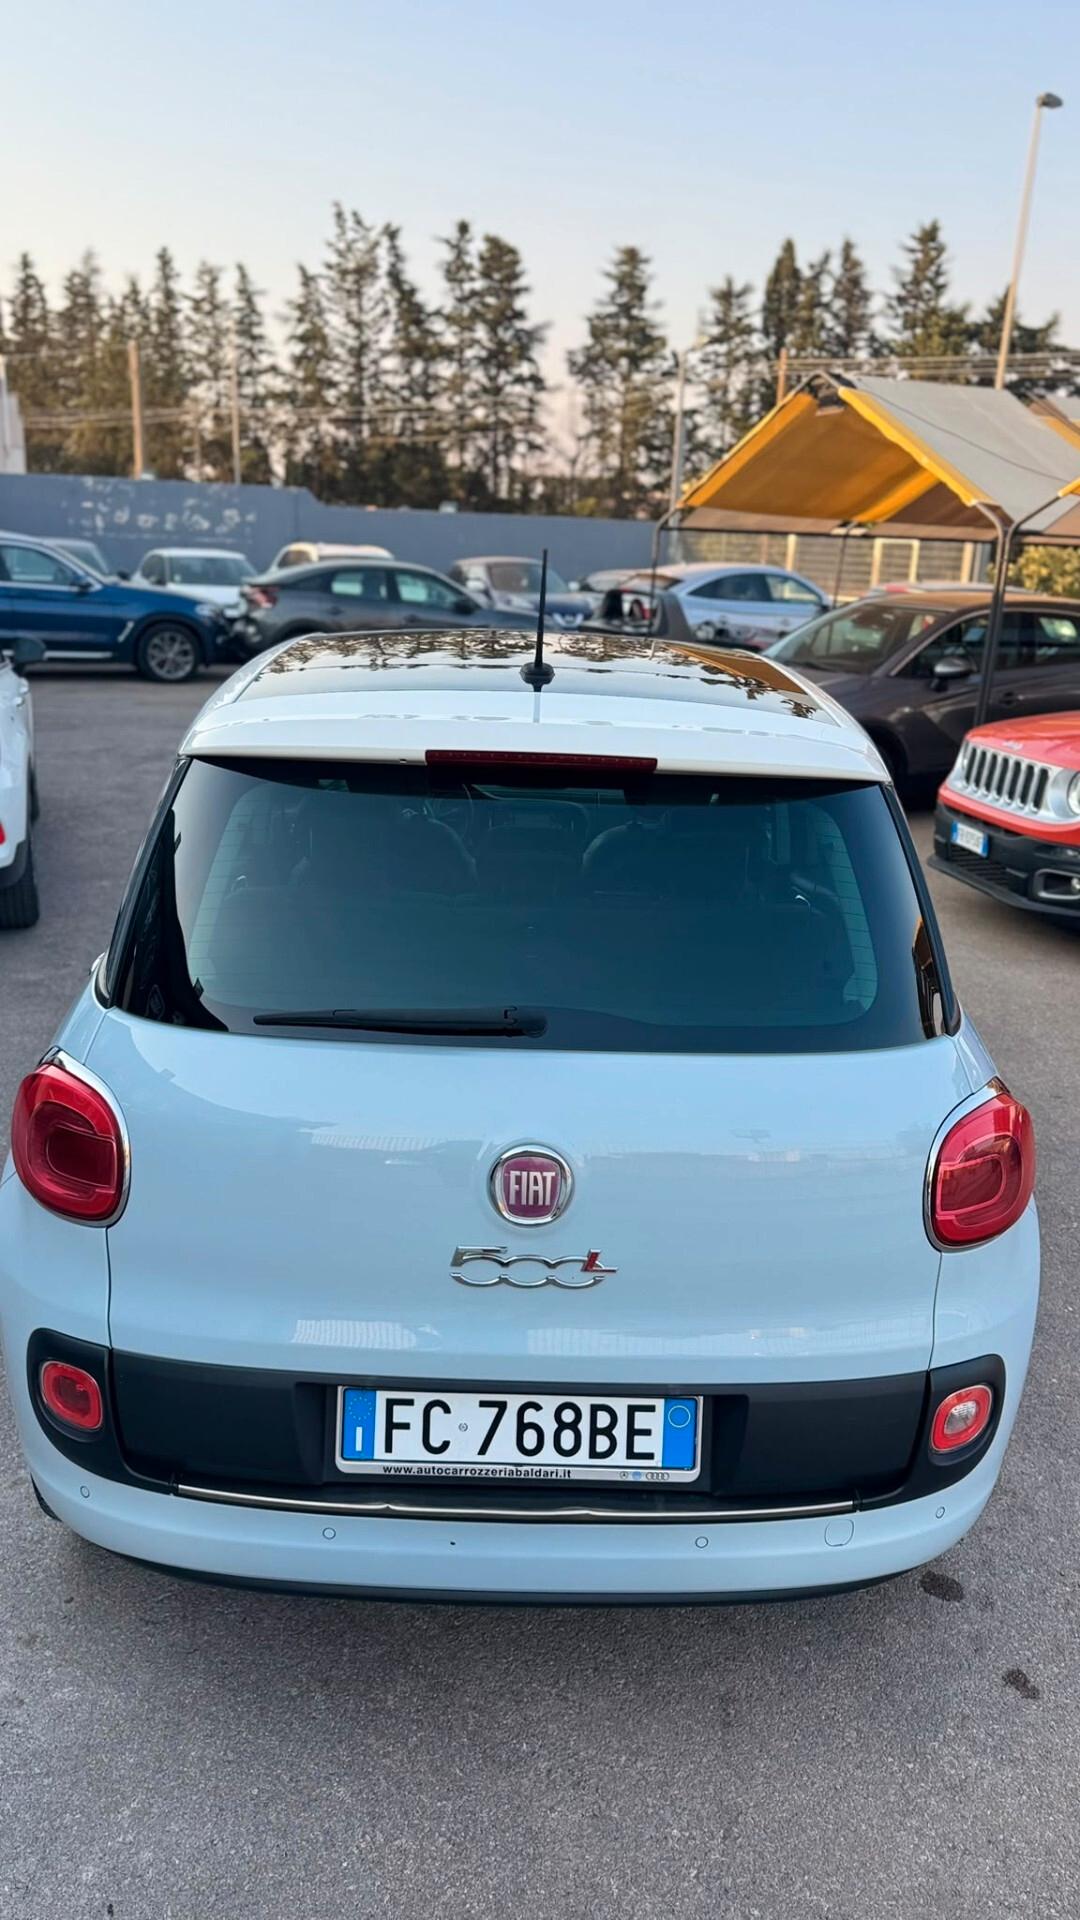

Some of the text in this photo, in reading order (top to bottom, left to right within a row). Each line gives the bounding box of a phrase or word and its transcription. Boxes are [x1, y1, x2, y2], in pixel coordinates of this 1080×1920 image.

[508, 1170, 556, 1206] FIAT
[450, 1246, 618, 1290] 500L
[355, 1398, 657, 1461] I FC 768BE
[383, 1464, 571, 1479] www.autocarrozzeriabaldari.it
